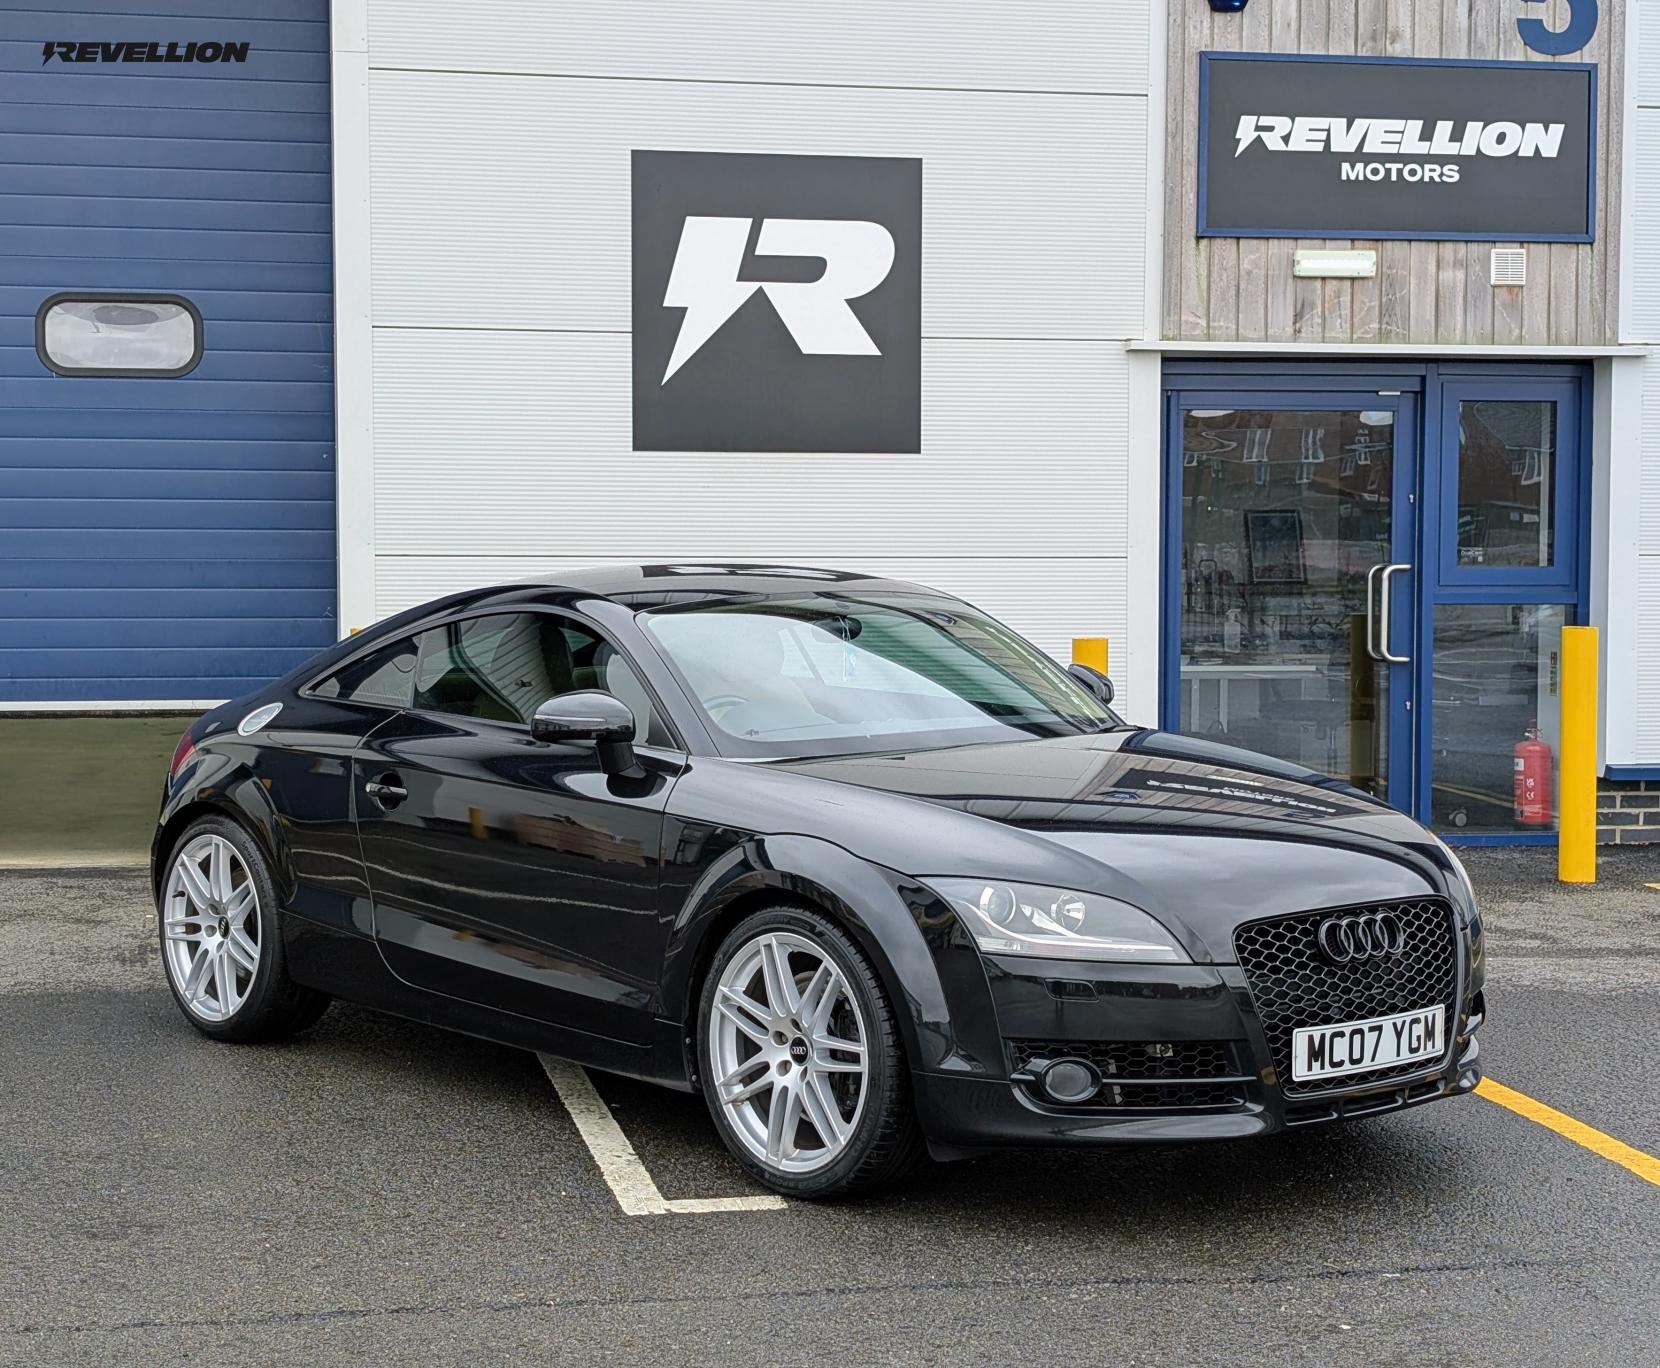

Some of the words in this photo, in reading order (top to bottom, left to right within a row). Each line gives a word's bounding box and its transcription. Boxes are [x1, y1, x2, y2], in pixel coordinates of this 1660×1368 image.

[1234, 115, 1565, 159] REVELLION
[1341, 162, 1461, 183] MOTORS
[1306, 1023, 1384, 1072] MC07
[1391, 1012, 1437, 1058] YGM
